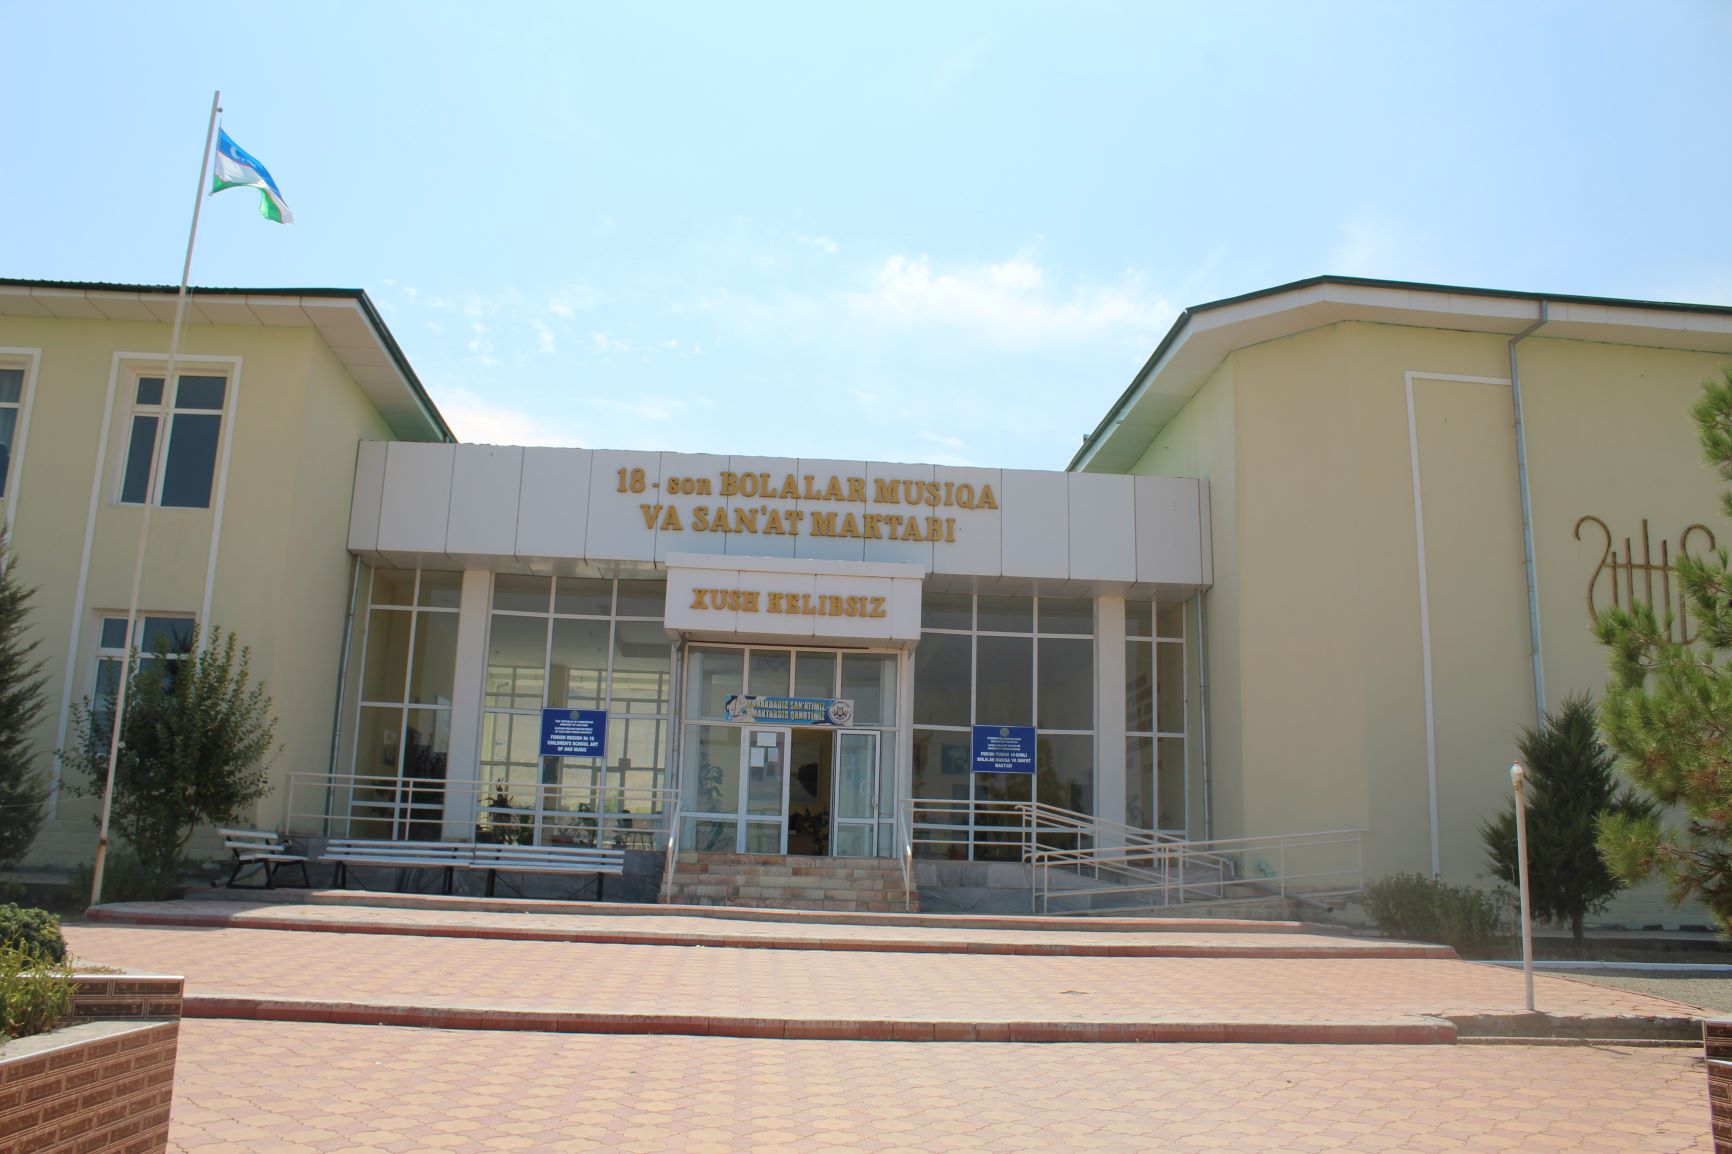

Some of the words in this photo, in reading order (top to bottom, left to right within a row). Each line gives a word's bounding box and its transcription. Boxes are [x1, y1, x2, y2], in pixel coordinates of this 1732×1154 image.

[617, 467, 646, 493] 18
[667, 477, 712, 496] son
[719, 471, 867, 503] BOLALAR
[873, 479, 999, 510] MUSIQA
[640, 504, 683, 531] VA
[692, 504, 803, 536] SAN'AT
[810, 511, 956, 543] MAKTABI
[690, 588, 760, 613] XUSH
[767, 592, 886, 618] KELIBSIZ
